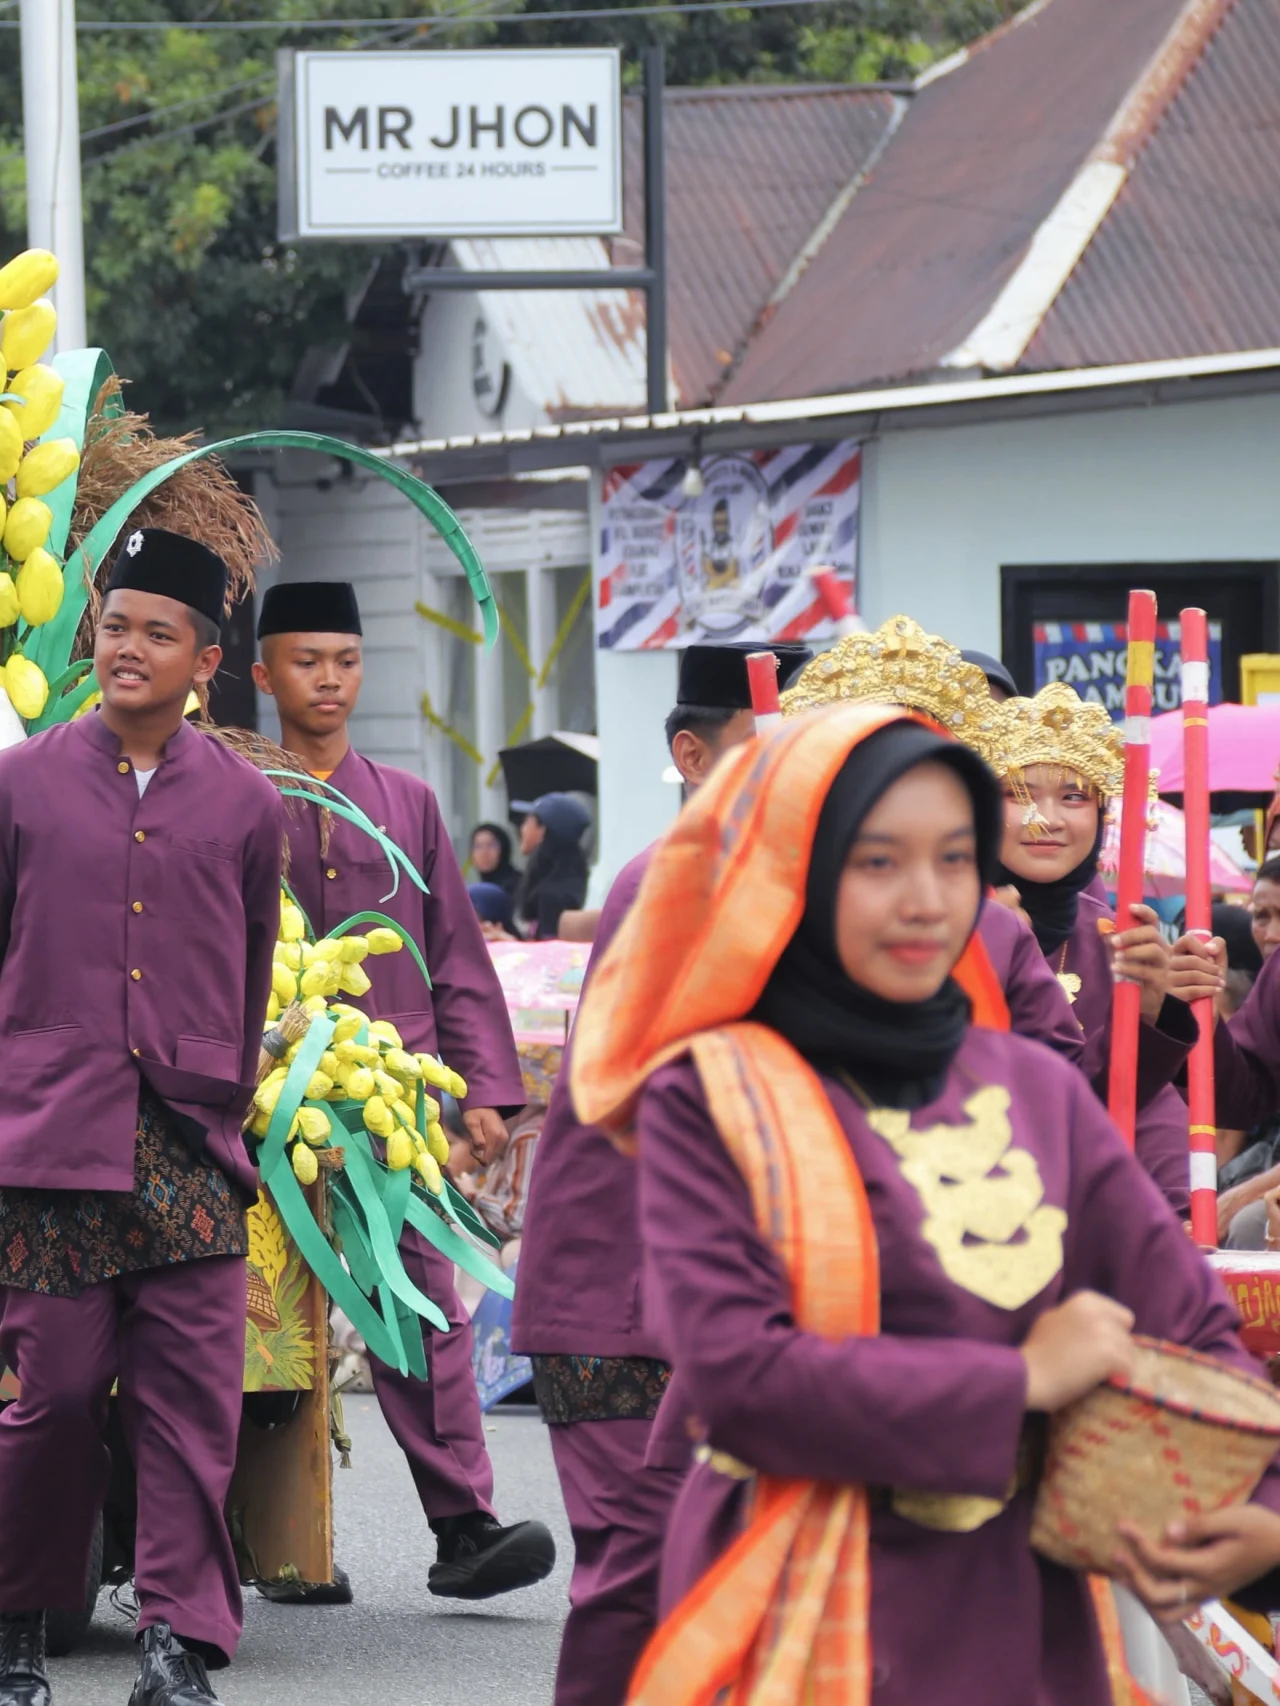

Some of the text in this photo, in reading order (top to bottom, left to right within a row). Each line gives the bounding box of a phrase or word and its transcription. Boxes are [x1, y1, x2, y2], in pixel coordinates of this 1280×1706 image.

[324, 103, 598, 150] MR JHON
[376, 160, 546, 179] COFFEE 24 HOURS
